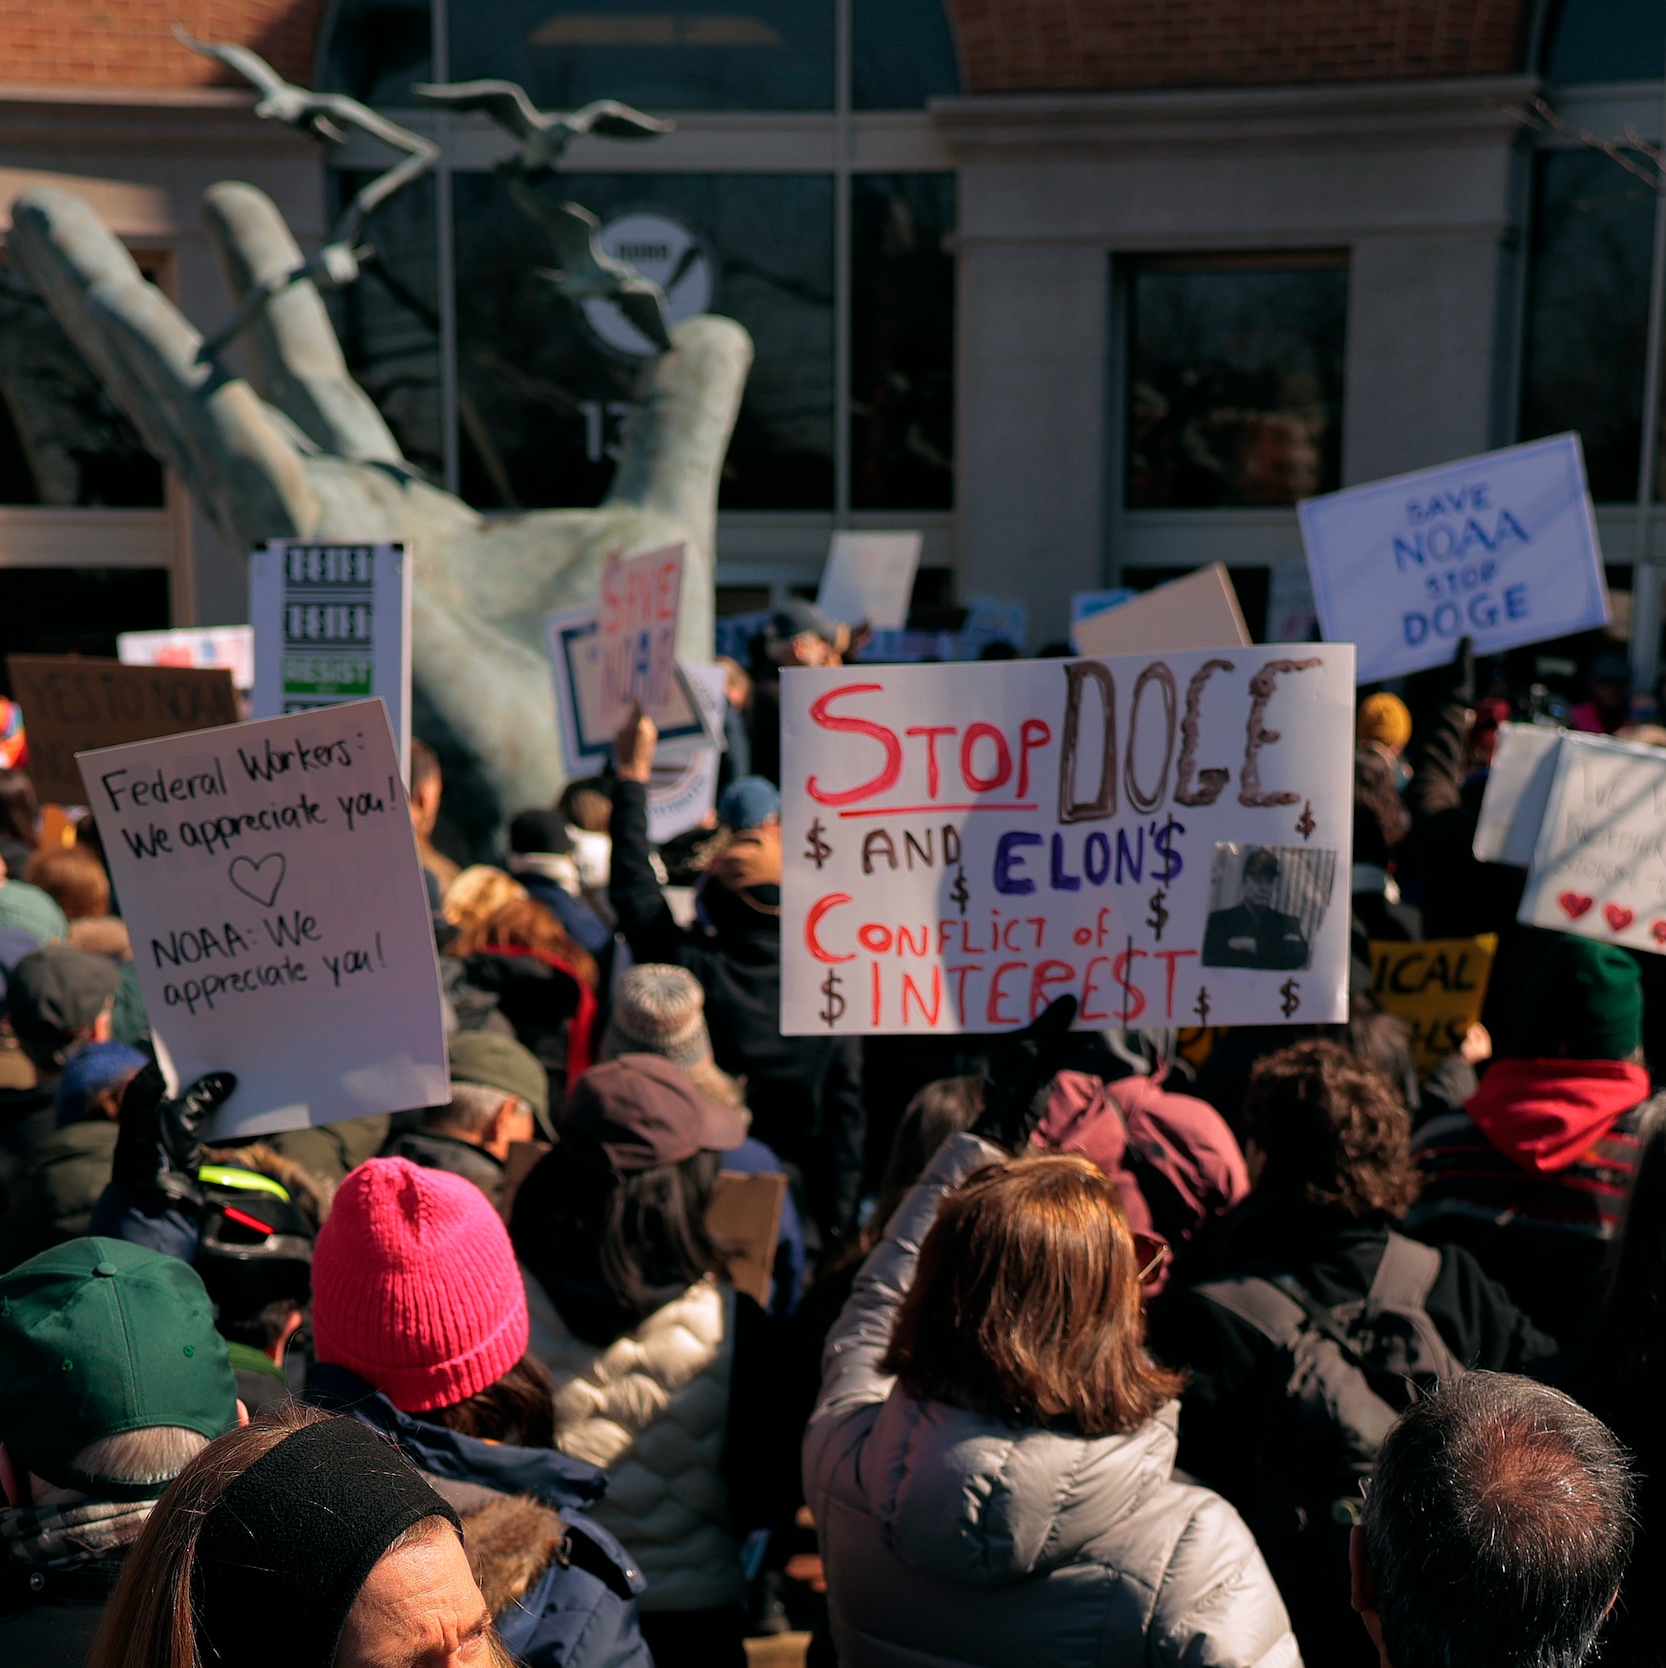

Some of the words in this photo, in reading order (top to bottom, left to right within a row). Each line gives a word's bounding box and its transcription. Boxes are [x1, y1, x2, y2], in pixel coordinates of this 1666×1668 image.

[1406, 482, 1491, 526] SAVE
[1391, 508, 1530, 574] NOAA
[1425, 561, 1497, 598] STOP
[1401, 582, 1528, 647] DOGE
[102, 757, 226, 812] Federal
[237, 732, 364, 782] Workers:
[1058, 658, 1324, 824] DOGE
[122, 824, 173, 859] We
[180, 794, 326, 854] appreciate
[338, 776, 397, 831] you!
[862, 825, 961, 875] AND
[151, 922, 259, 969] NOAA:
[263, 911, 322, 947] We
[1375, 951, 1476, 993] ICAL
[163, 955, 308, 1015] appreciate
[323, 932, 386, 987] you!
